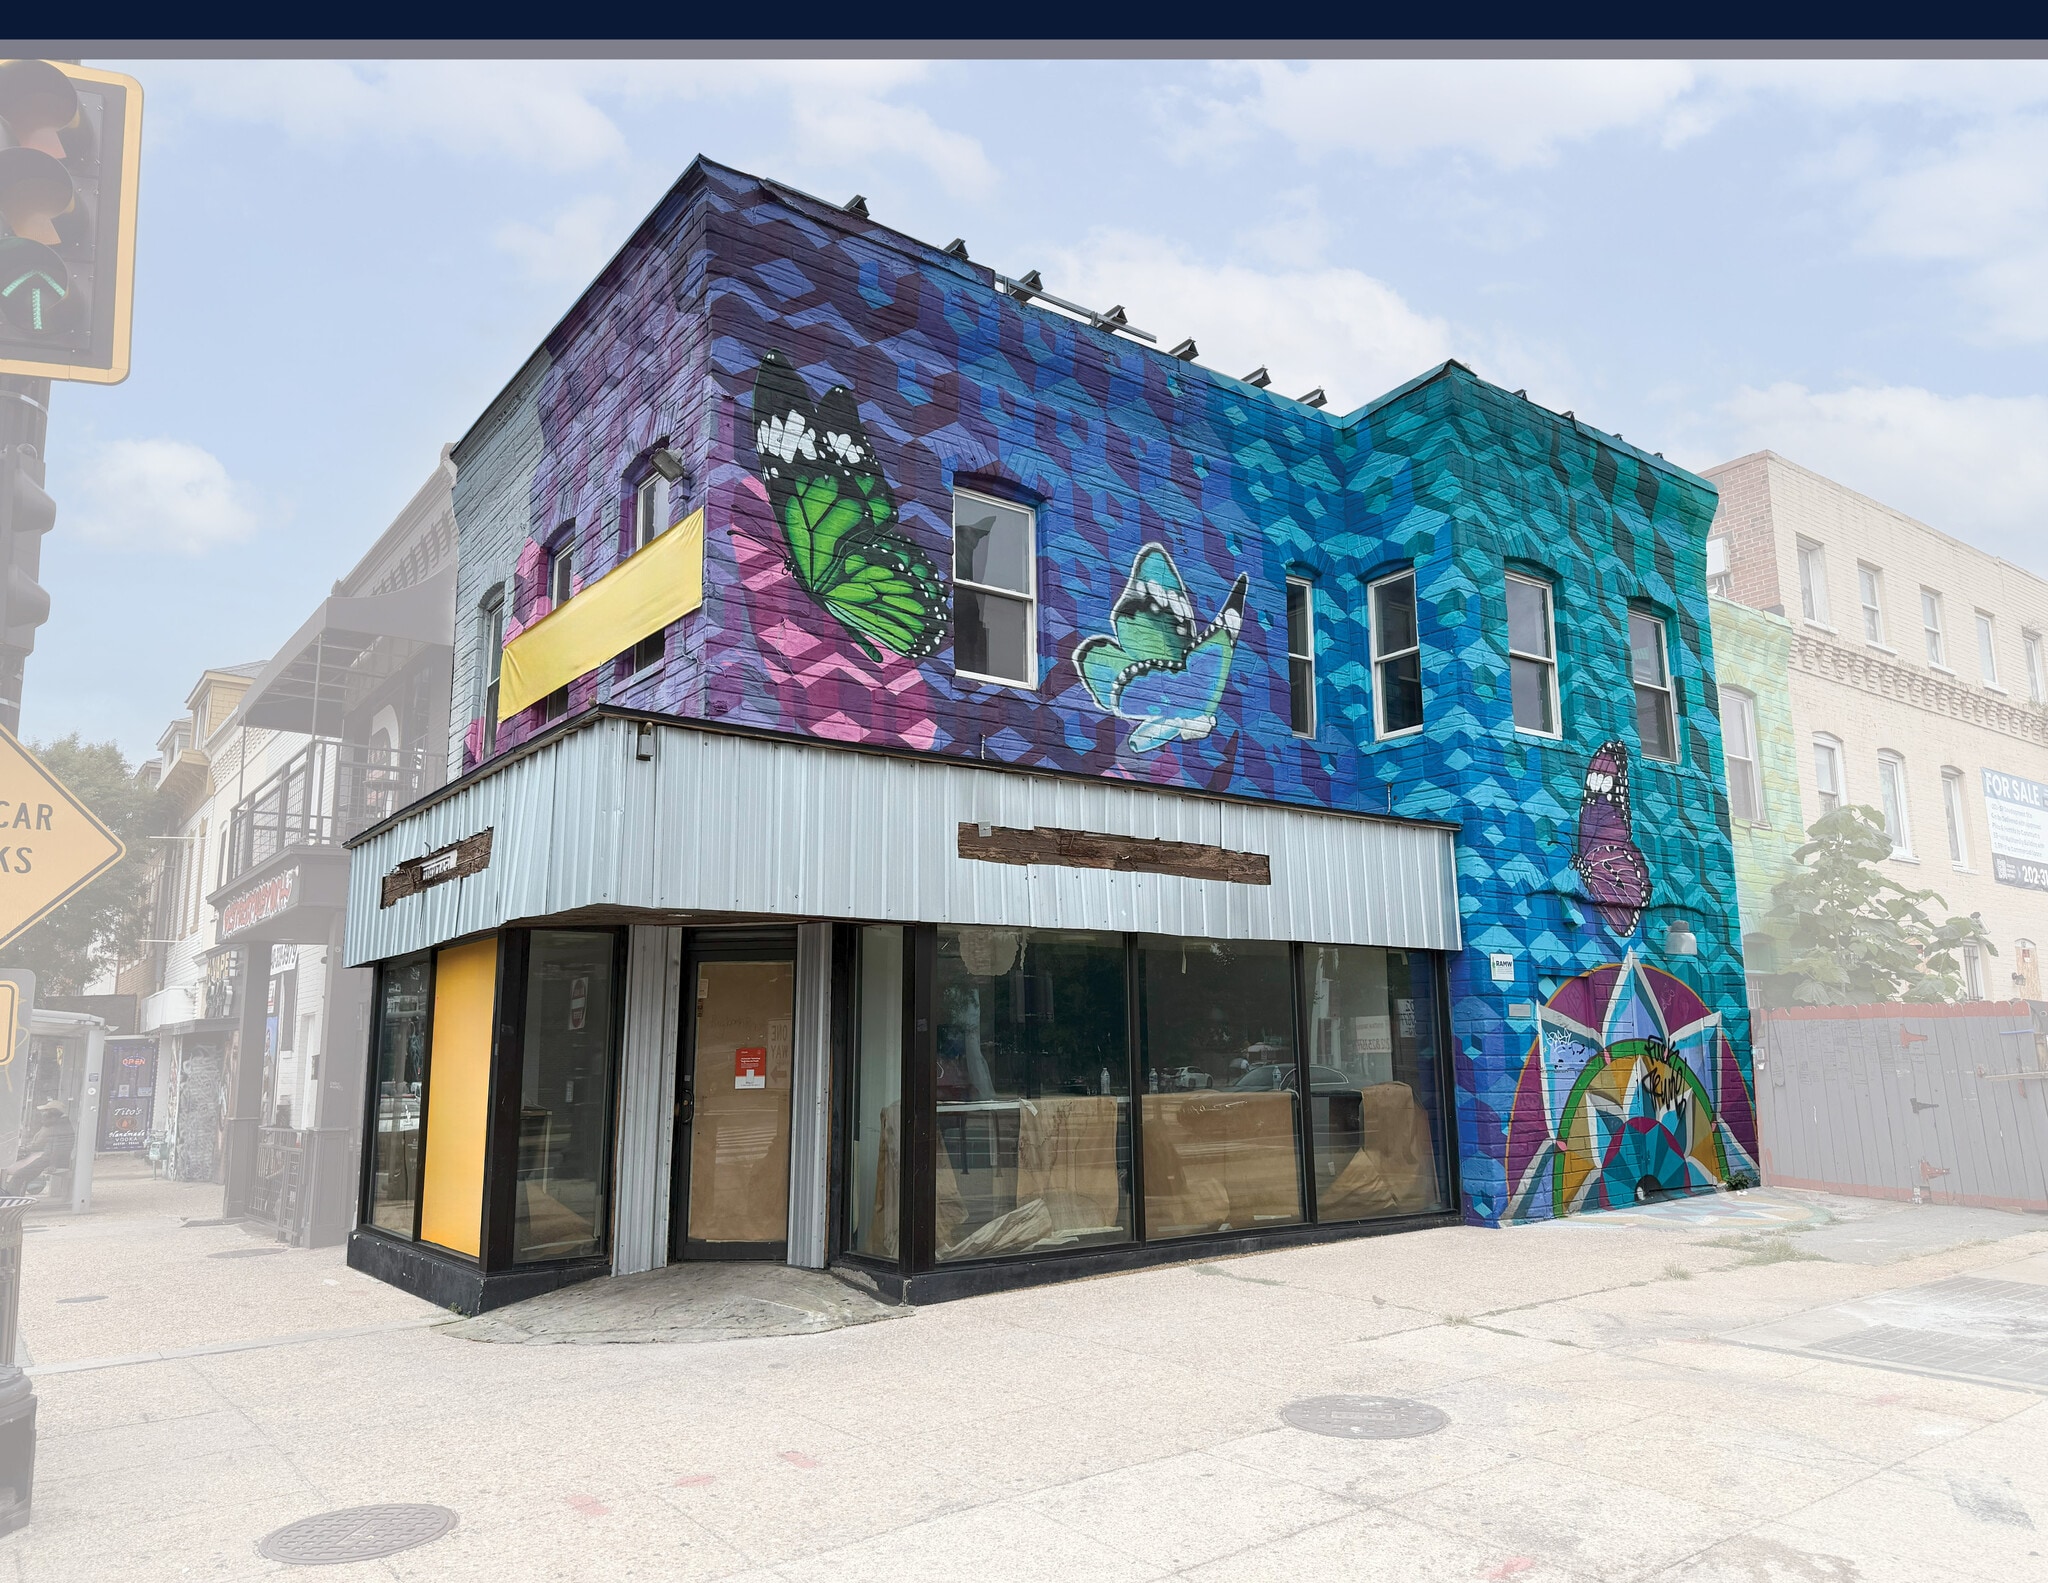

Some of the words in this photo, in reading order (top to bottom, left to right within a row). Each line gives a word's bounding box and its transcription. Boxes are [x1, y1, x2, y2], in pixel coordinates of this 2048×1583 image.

[1984, 771, 2011, 798] FOR
[2012, 780, 2040, 805] SALE
[114, 1107, 142, 1116] Tito's
[108, 1129, 146, 1138] Handmade
